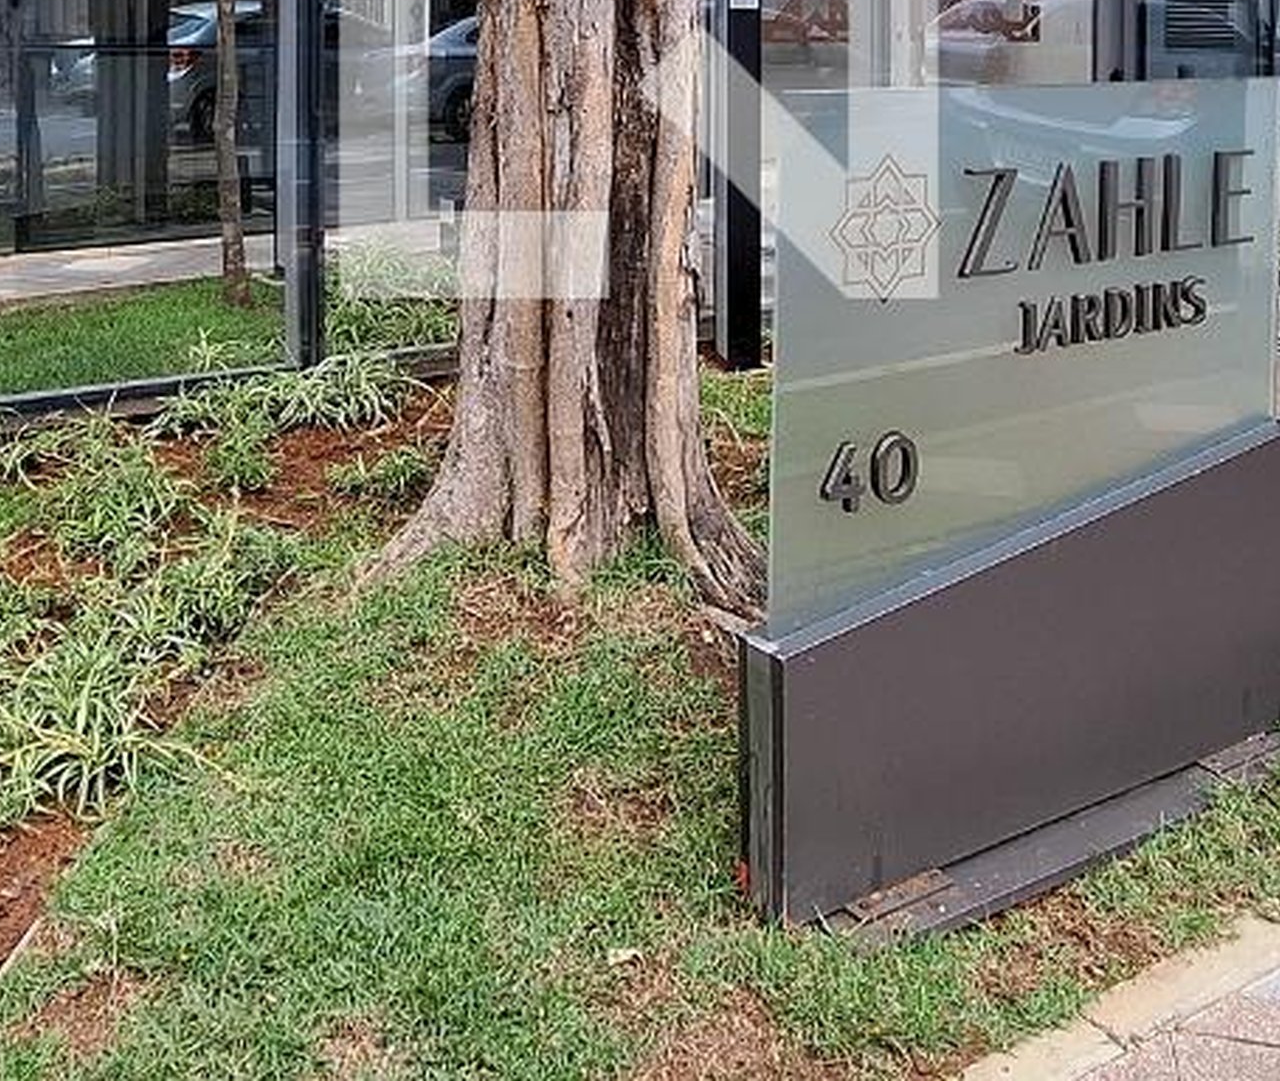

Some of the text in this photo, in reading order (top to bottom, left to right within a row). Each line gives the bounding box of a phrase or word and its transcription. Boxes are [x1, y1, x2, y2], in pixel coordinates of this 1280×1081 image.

[957, 149, 1256, 279] ZAHLE
[1014, 275, 1208, 355] JARDINS
[820, 430, 920, 514] 40
